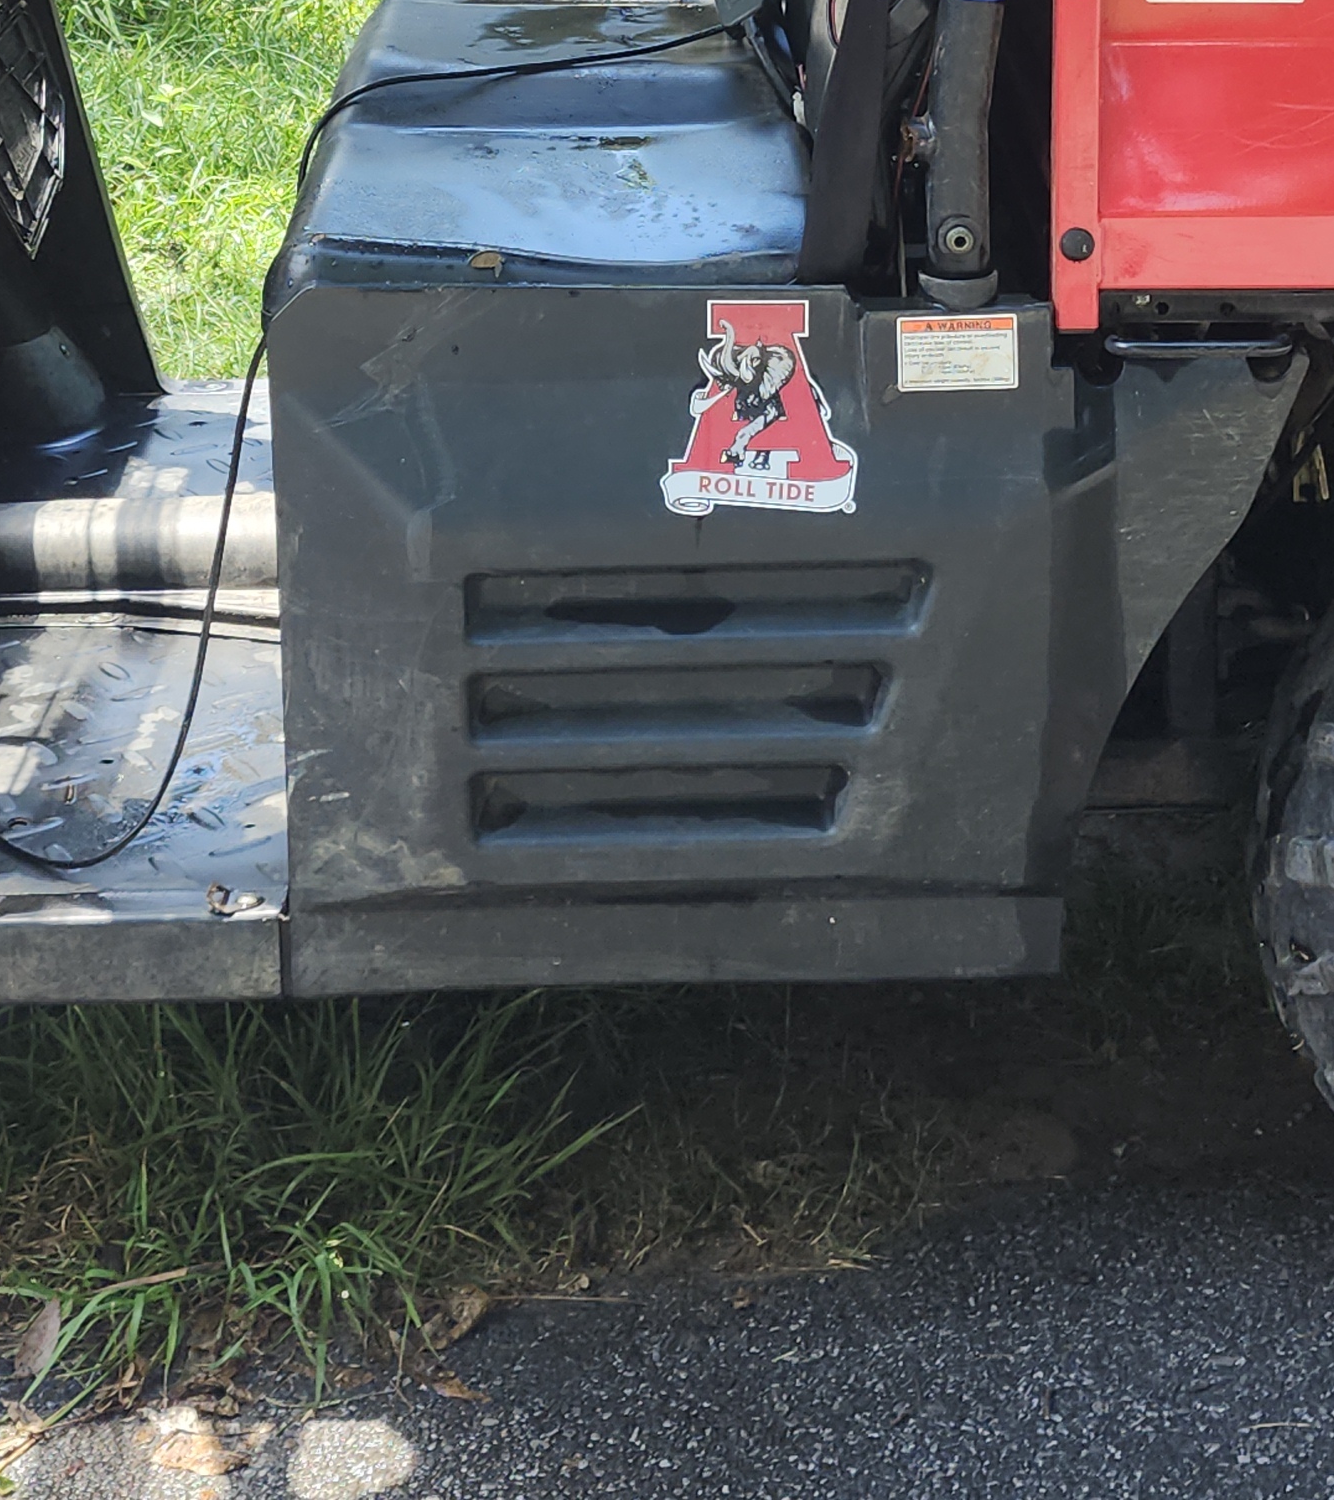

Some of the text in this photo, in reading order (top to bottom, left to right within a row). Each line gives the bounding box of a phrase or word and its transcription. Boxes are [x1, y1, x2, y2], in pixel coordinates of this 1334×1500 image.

[937, 320, 992, 331] WARNING
[698, 475, 816, 502] ROLL TIDE
